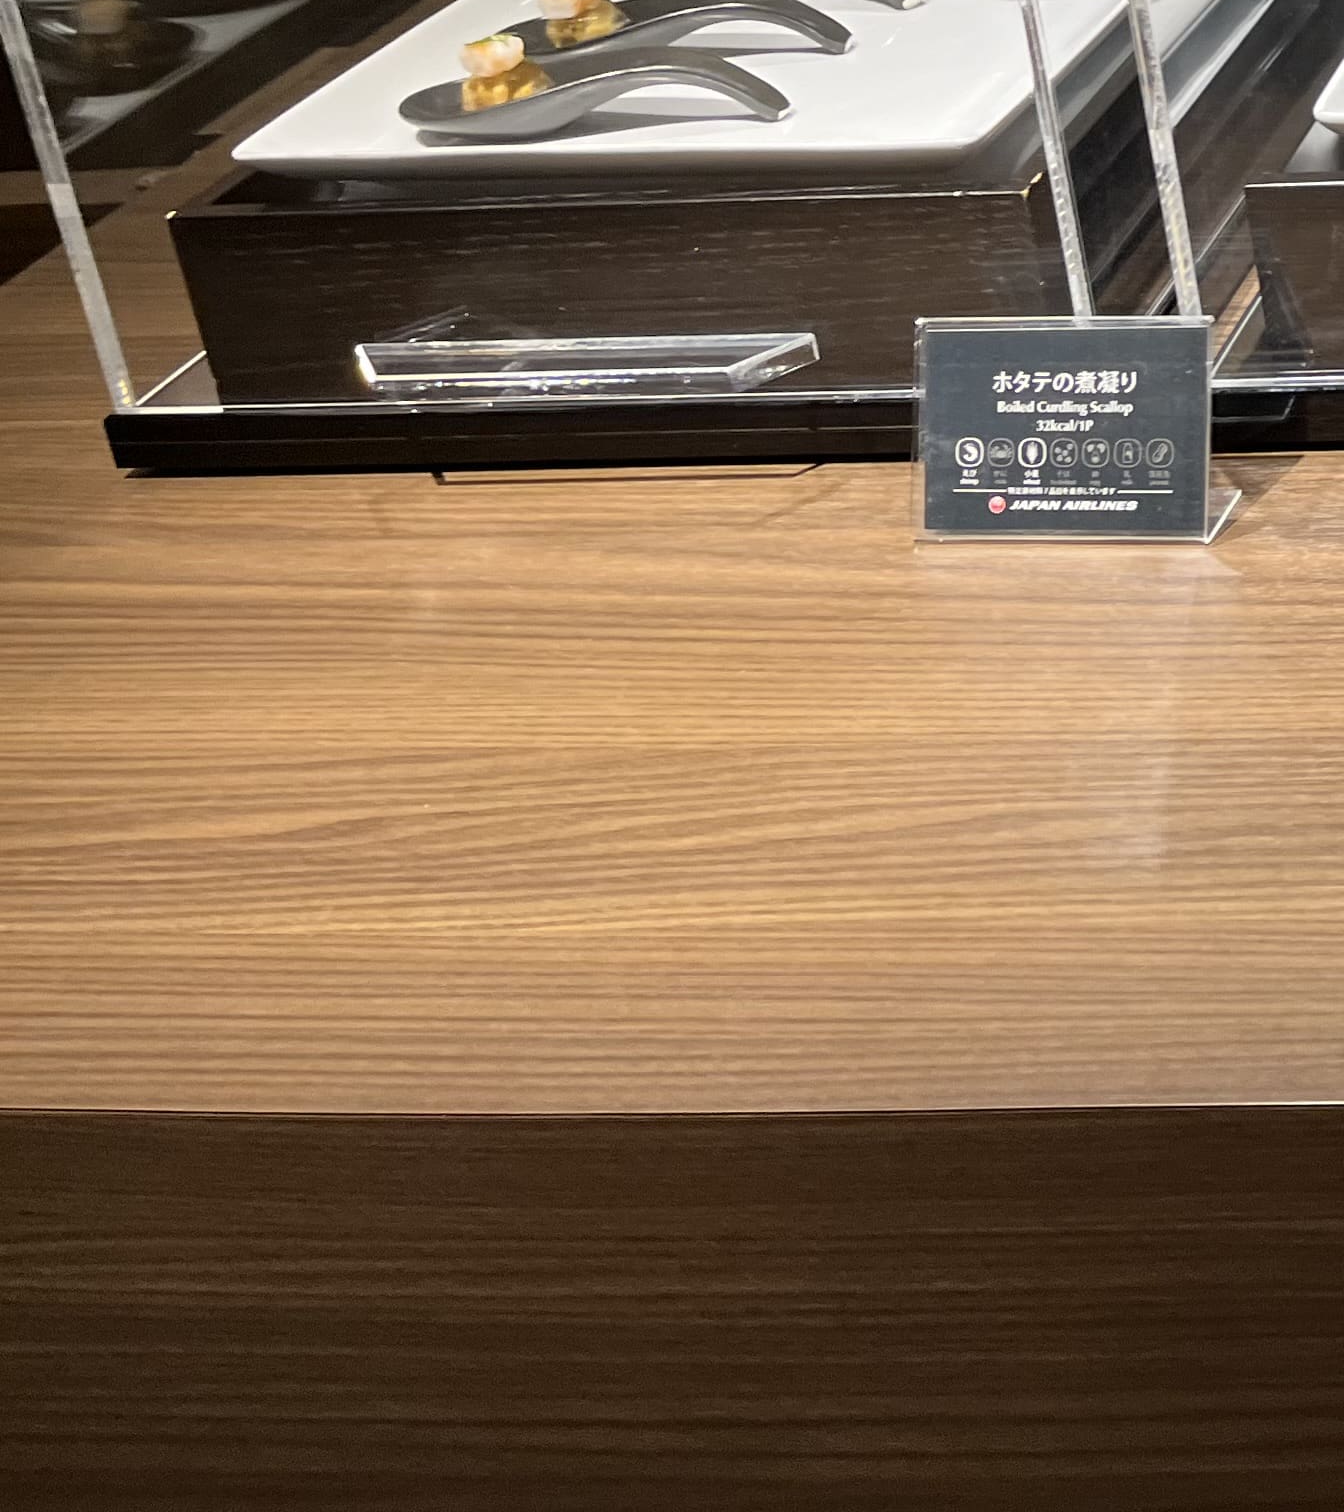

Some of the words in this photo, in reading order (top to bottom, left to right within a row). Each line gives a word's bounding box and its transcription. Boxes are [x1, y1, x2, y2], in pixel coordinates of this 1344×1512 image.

[992, 370, 1138, 394] ホタテの煮凝り
[997, 400, 1035, 413] Boiled
[1089, 400, 1134, 416] Scallop
[1036, 419, 1095, 432] 32kcal/1P
[1009, 500, 1061, 511] JAPAN
[1062, 500, 1139, 511] AIRLINES
